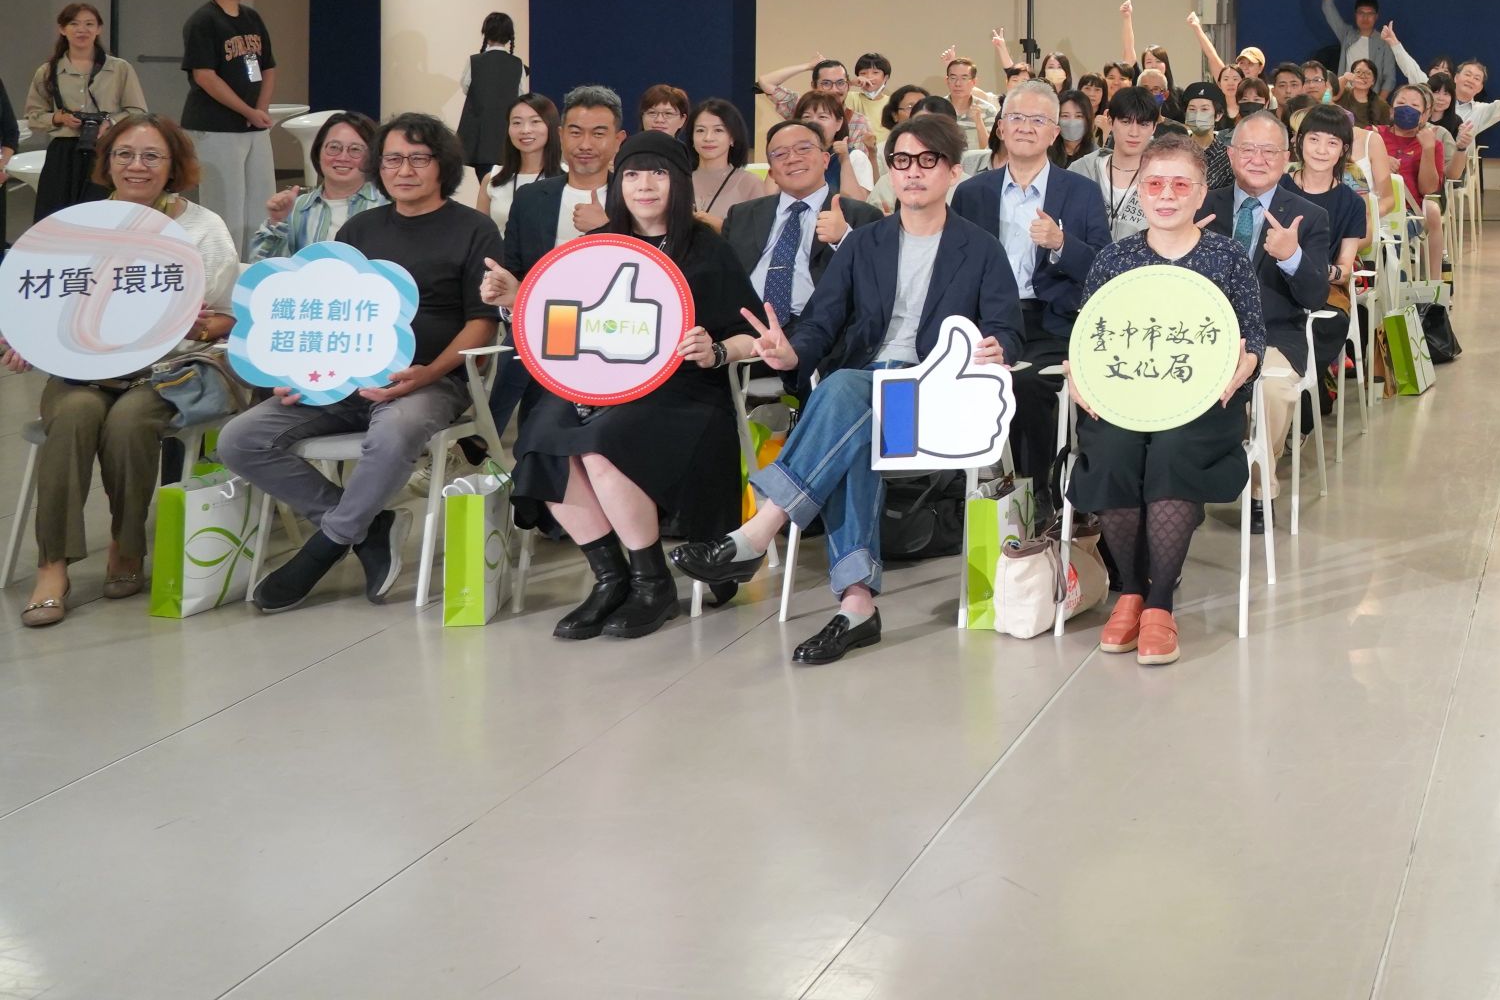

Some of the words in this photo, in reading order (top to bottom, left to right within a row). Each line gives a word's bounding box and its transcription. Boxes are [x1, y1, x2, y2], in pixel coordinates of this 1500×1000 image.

[18, 267, 98, 300] 材質
[112, 262, 185, 295] 環境
[271, 297, 380, 322] 纖維創作
[1090, 316, 1222, 352] 臺中市政府
[1104, 353, 1194, 384] 文化局
